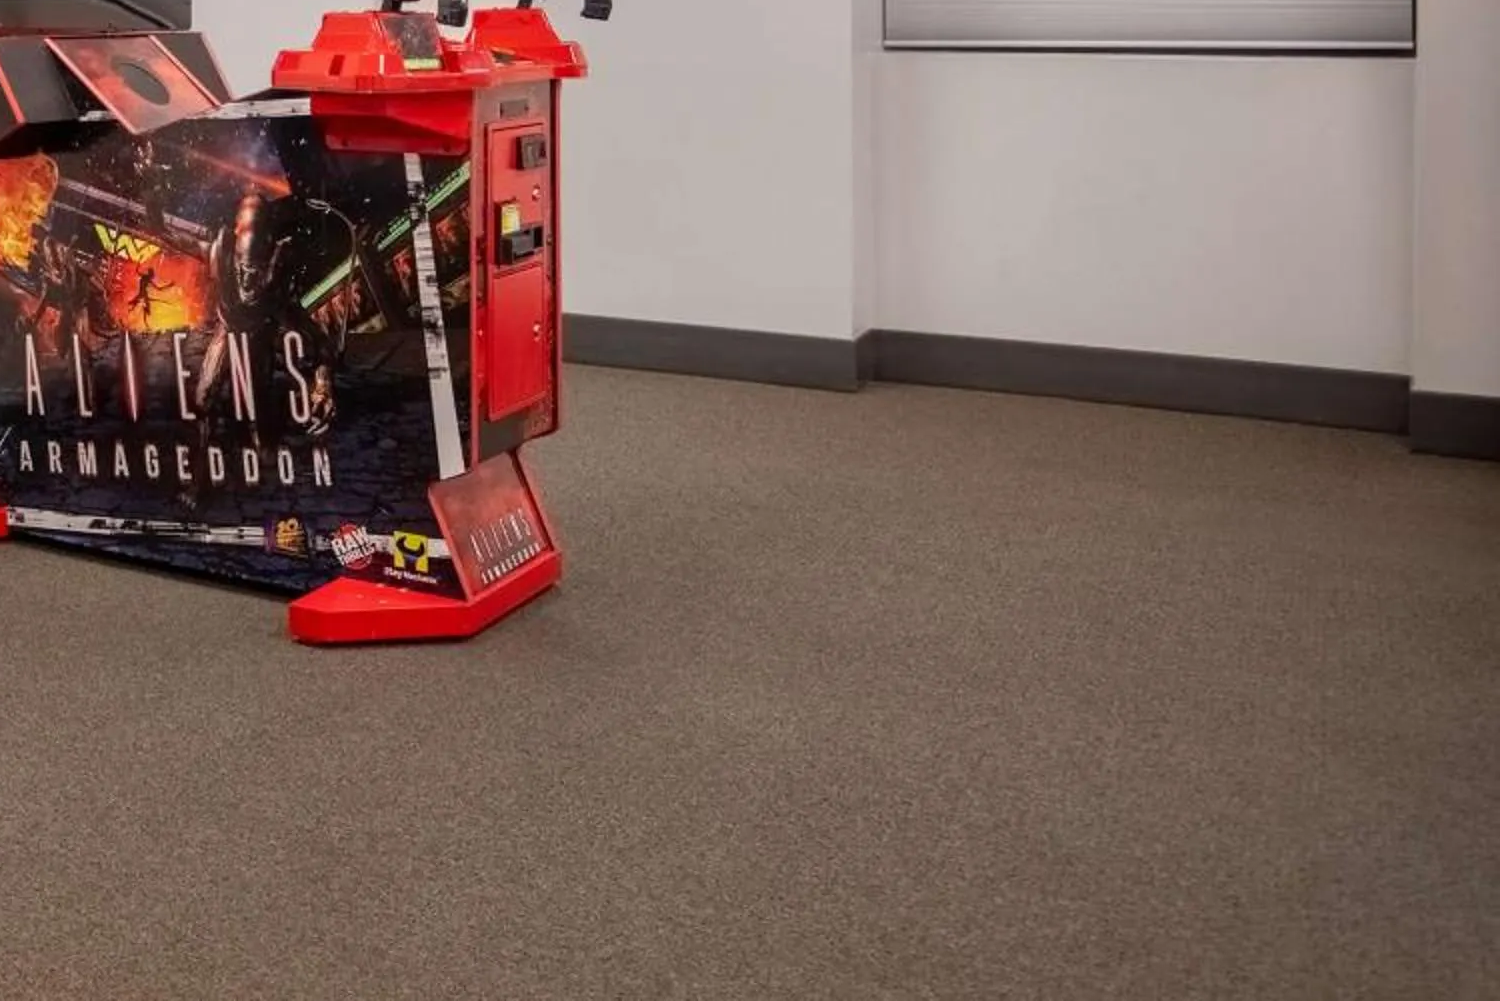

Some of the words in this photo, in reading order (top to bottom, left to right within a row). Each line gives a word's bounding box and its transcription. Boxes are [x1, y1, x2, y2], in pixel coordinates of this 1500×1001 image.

[25, 330, 311, 424] ALIENS
[18, 439, 334, 488] ARMAGEDDON
[331, 526, 368, 559] RAW
